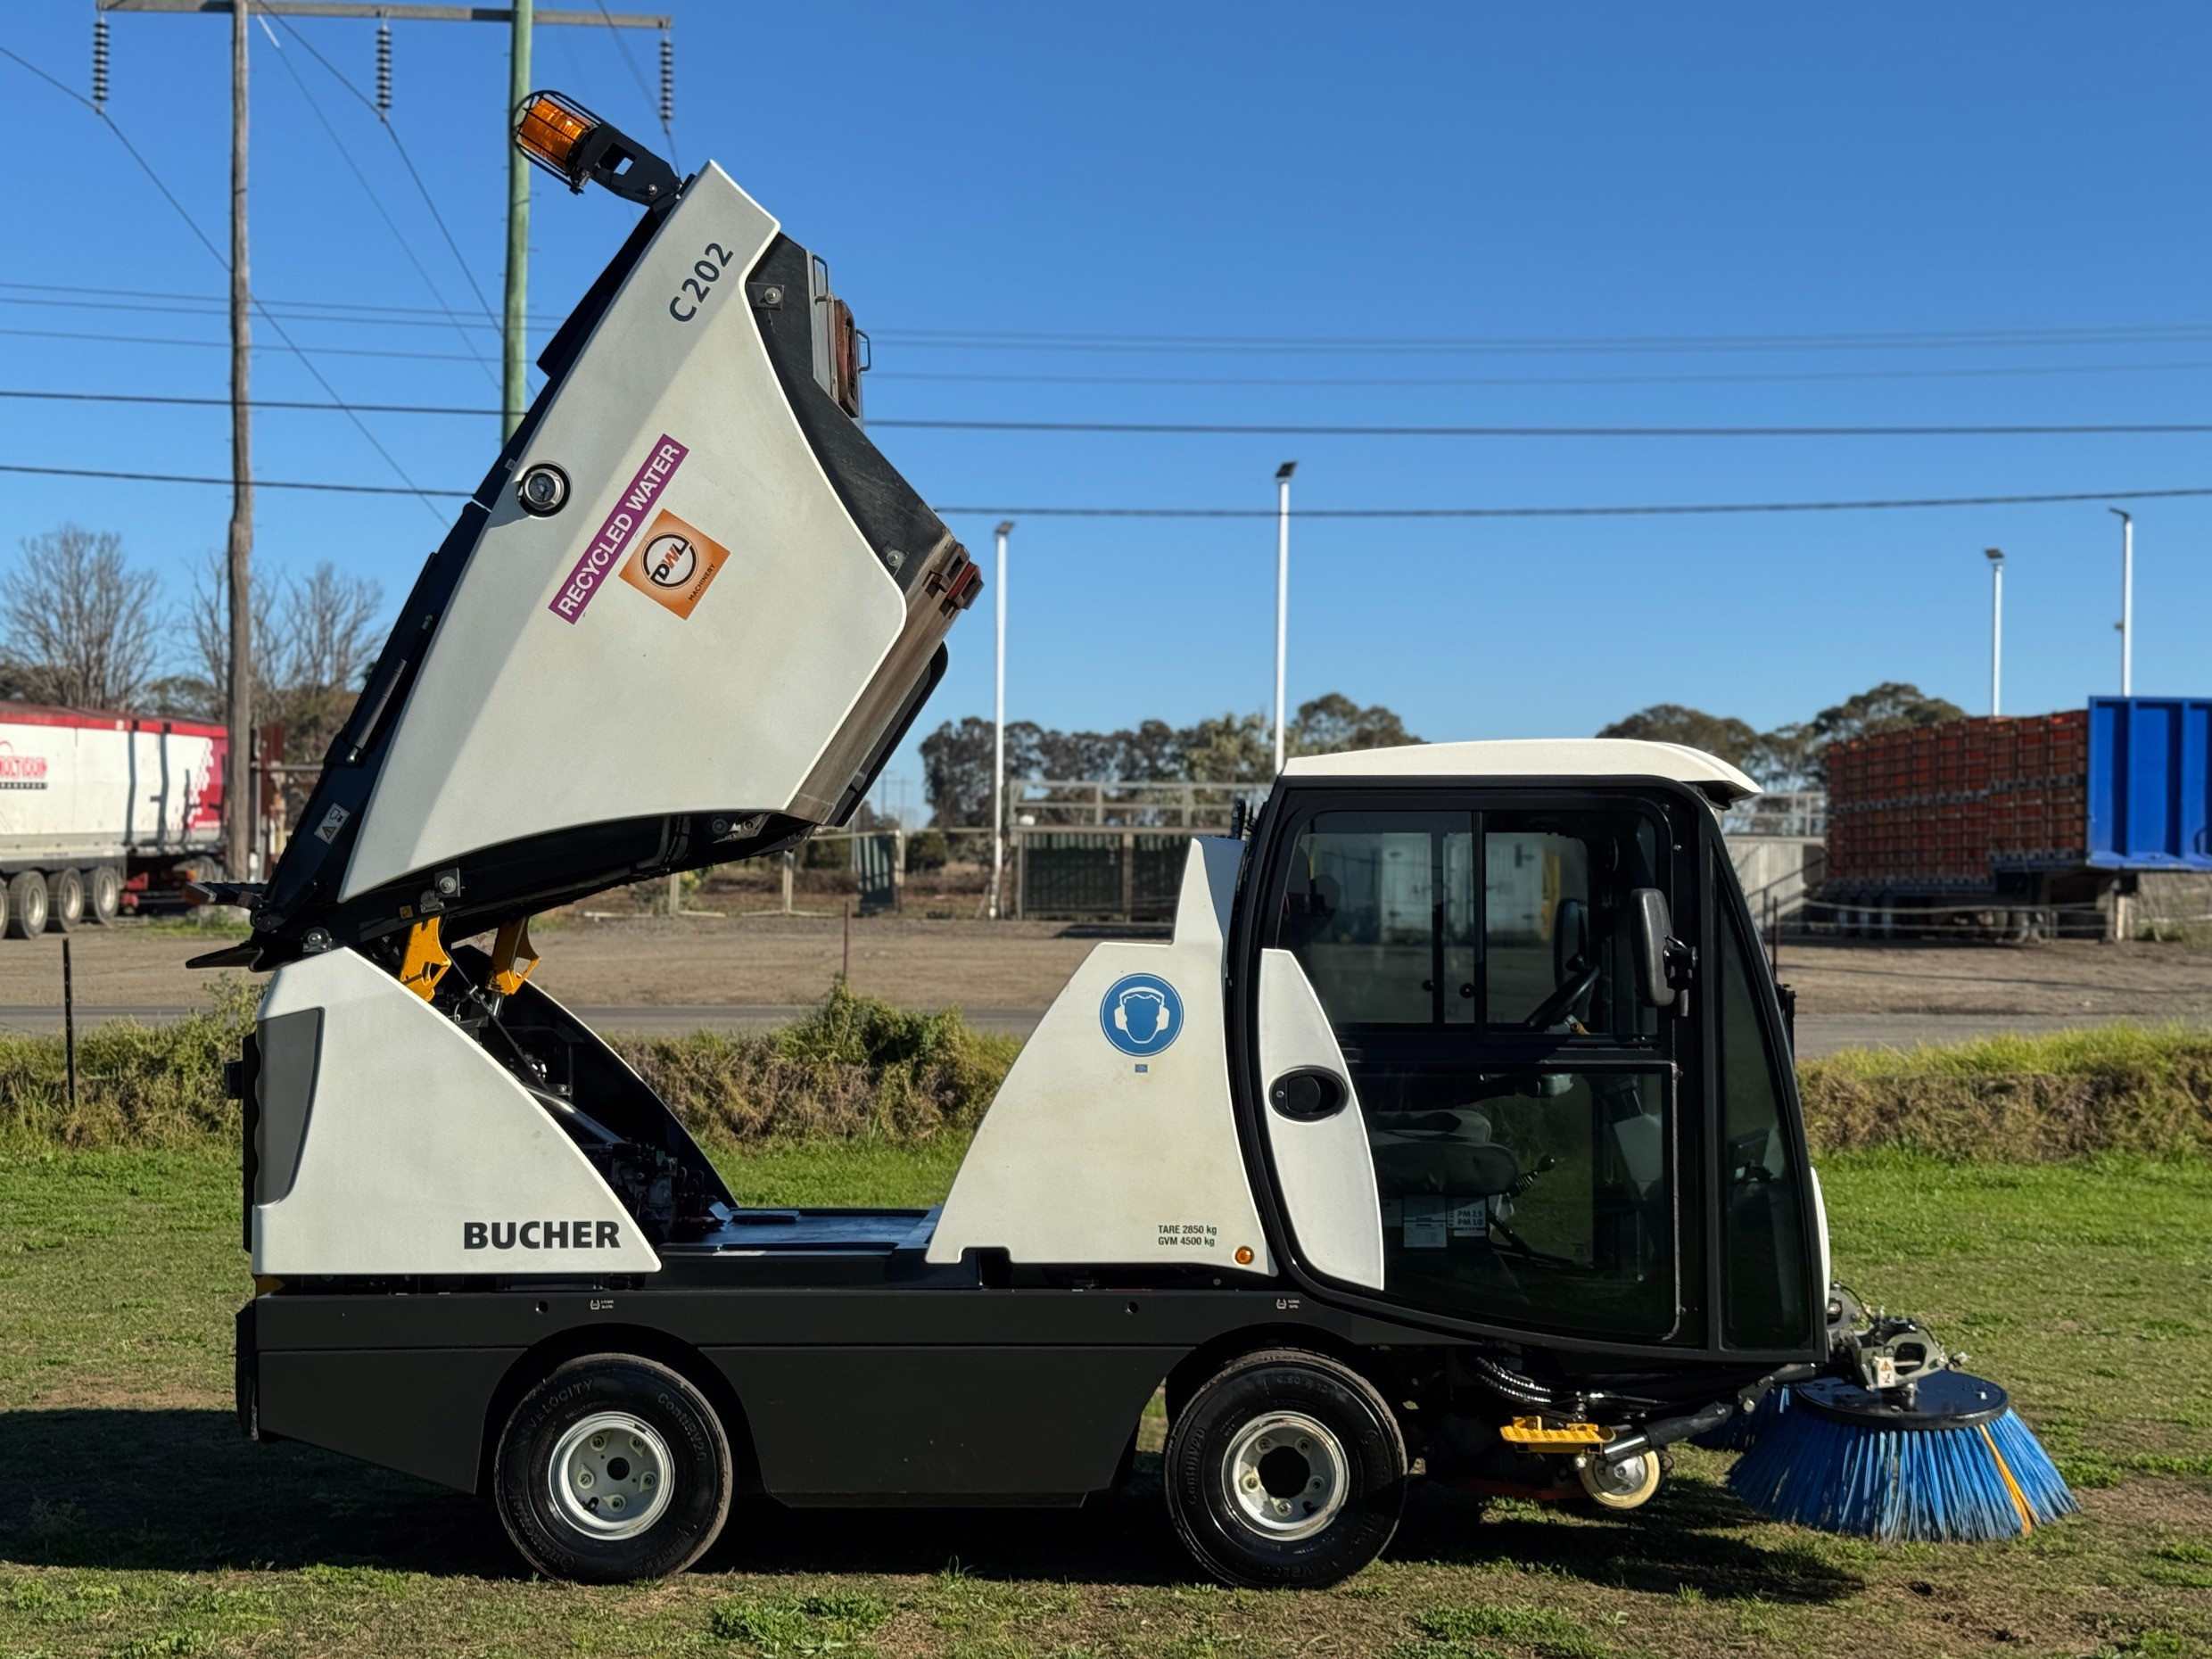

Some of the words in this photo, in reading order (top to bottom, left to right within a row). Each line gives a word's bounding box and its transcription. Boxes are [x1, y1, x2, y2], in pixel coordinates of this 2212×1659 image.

[669, 242, 734, 322] C202
[557, 513, 632, 616] RECYCLED
[625, 443, 681, 512] WATER
[650, 540, 690, 582] DWL
[688, 563, 716, 602] MACHINERY
[464, 1221, 622, 1250] BUCHER
[1158, 1225, 1180, 1234] TARE
[1182, 1225, 1204, 1234] 2850
[1206, 1225, 1217, 1236] kg
[1158, 1236, 1178, 1245] GVM
[1180, 1236, 1202, 1245] 4500
[1204, 1236, 1215, 1247] kg
[528, 1378, 595, 1428] VELOCITY
[657, 1392, 707, 1462] ContiRV20
